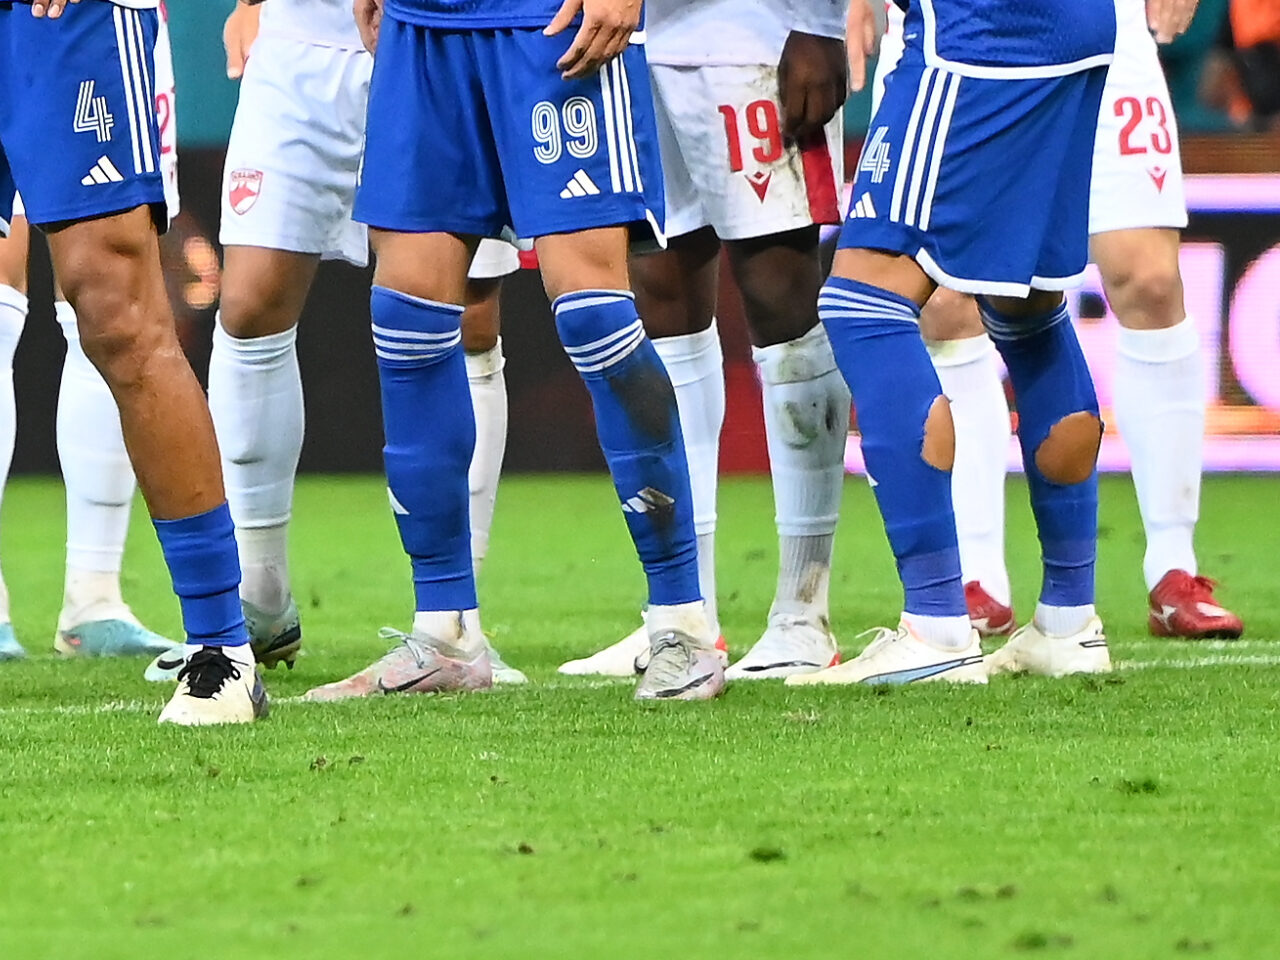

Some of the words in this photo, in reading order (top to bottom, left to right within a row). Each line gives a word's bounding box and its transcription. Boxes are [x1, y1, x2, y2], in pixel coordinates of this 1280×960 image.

[73, 80, 114, 143] 4
[532, 96, 598, 165] 99
[718, 99, 784, 173] 19
[1113, 96, 1172, 156] 23
